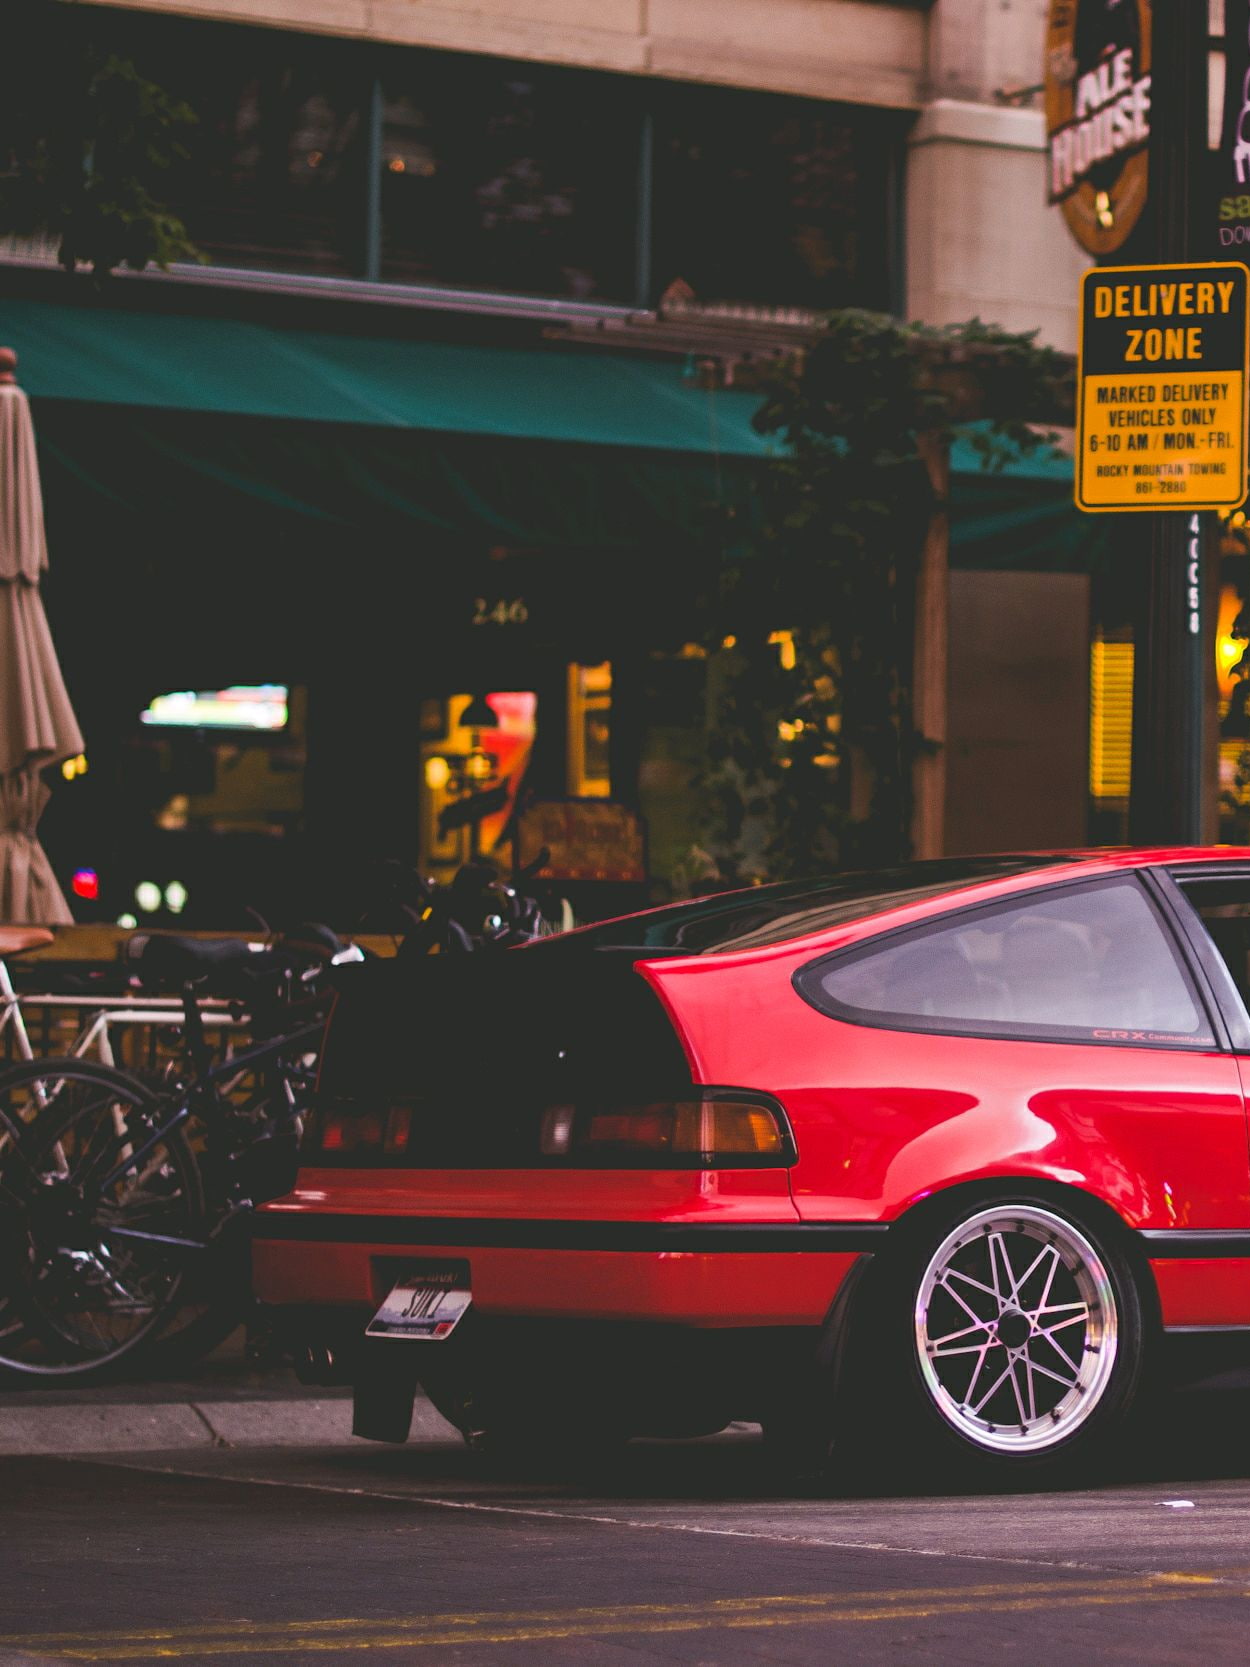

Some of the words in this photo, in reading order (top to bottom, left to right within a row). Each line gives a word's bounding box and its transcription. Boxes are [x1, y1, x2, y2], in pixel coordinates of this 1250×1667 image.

[1076, 48, 1132, 118] ALE
[1051, 76, 1151, 194] HOUSE
[1094, 281, 1235, 318] DELIVERY
[1124, 327, 1203, 362] ZONE
[1097, 385, 1156, 404] MARKED
[1162, 383, 1229, 402] DELIVERY
[1109, 409, 1176, 428] VEHICLES
[1182, 408, 1217, 425] ONLY
[1090, 434, 1121, 452] 6-10
[1127, 434, 1149, 450] AM
[1097, 464, 1129, 477] ROCKY
[1133, 463, 1184, 476] MOUNTAIN
[1188, 462, 1226, 475] TOWING
[472, 597, 528, 625] 246
